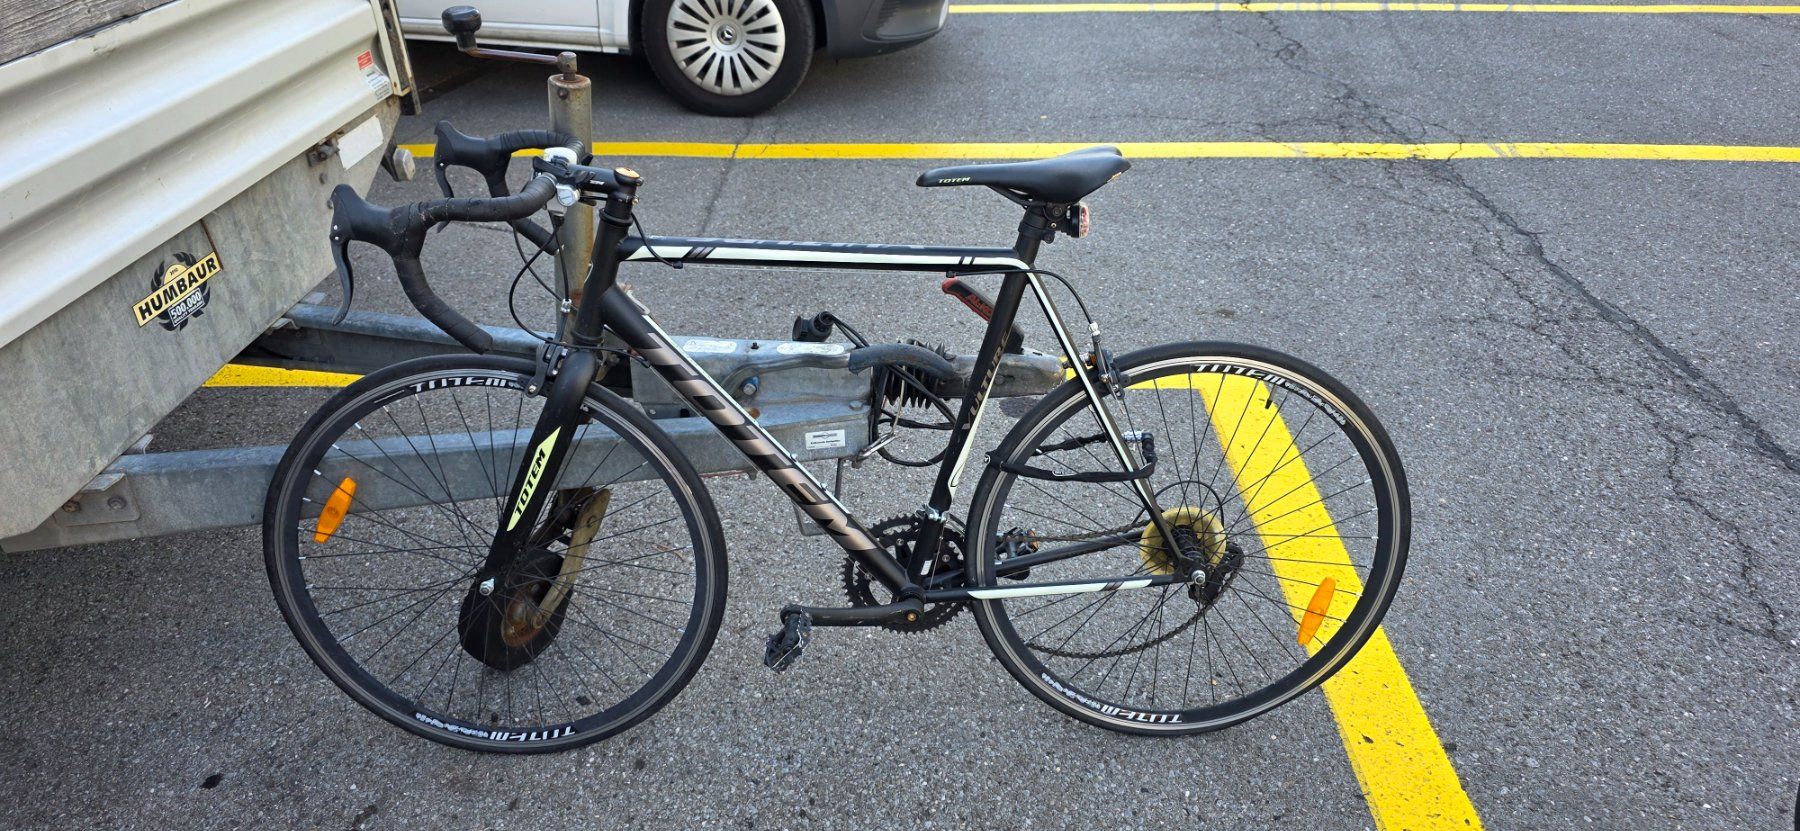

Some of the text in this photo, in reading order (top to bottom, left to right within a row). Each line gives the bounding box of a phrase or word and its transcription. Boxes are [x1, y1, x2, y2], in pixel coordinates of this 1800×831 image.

[938, 176, 971, 184] TOTEM
[138, 257, 217, 321] HUMBAUR
[170, 291, 202, 319] 500.000
[961, 328, 1011, 430] VULTURE
[647, 332, 878, 551] TOTEM
[514, 447, 546, 516] TOTEM
